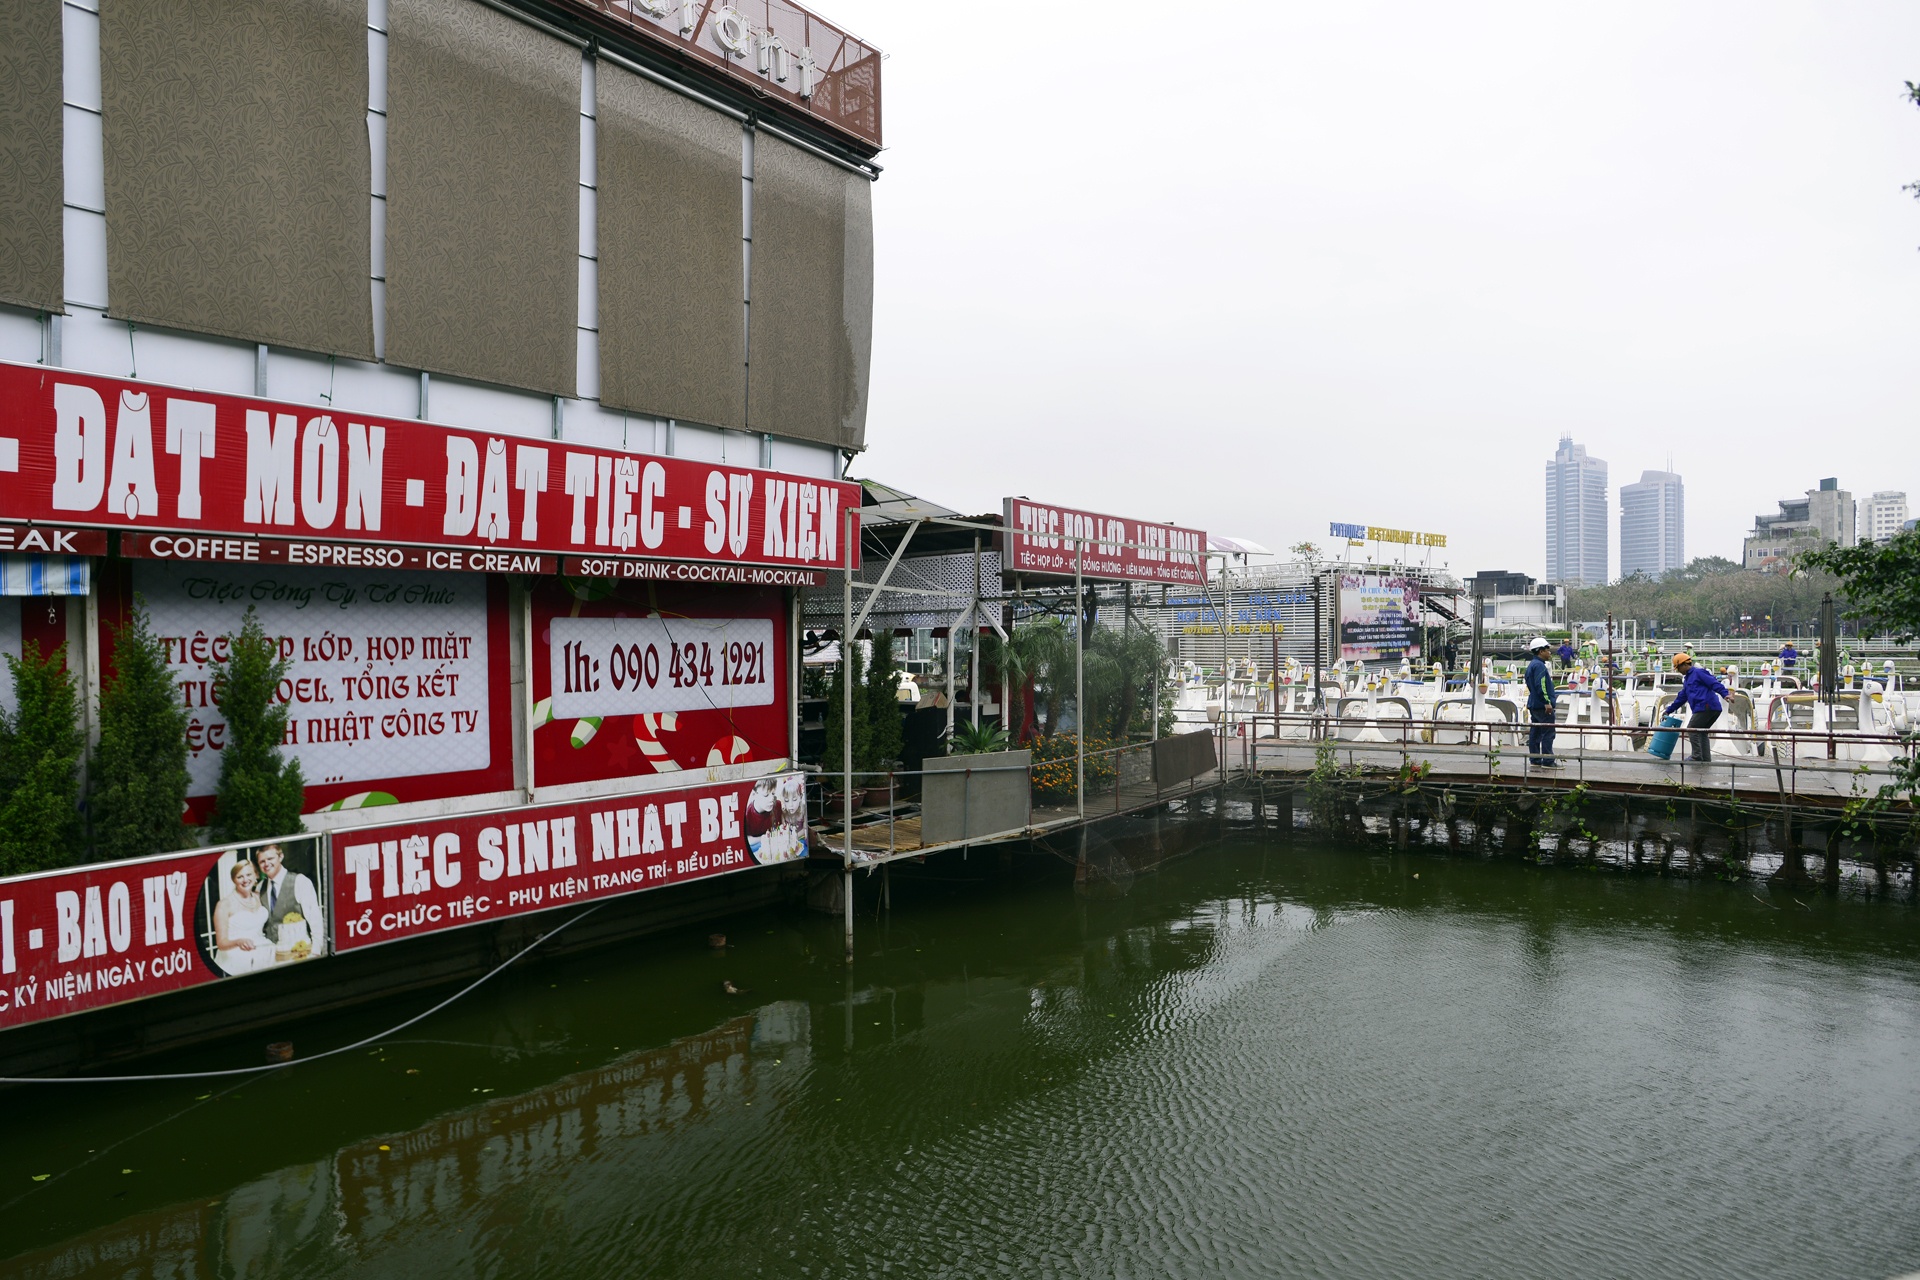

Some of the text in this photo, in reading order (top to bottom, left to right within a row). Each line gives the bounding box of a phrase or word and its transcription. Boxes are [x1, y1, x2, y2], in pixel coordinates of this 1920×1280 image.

[52, 382, 216, 520] ĐẶT
[243, 409, 386, 531] MÓN
[443, 434, 548, 544] ĐẶT
[565, 451, 666, 552] TIỆC
[704, 470, 753, 559] SỰ
[763, 478, 839, 564] KIỆN
[150, 536, 260, 562] COFFEE
[288, 544, 404, 567] ESPRESSO
[426, 551, 461, 570] ICE
[469, 552, 541, 573] CREAM
[1020, 505, 1059, 549] TIỆC
[1098, 517, 1125, 557] LỚP
[1137, 525, 1165, 562] LIÊN
[1169, 530, 1199, 565] HOAN
[1367, 526, 1413, 545] RESTAURANT
[1423, 533, 1447, 547] COFFEE
[580, 559, 620, 577] SOFT
[1138, 565, 1153, 577] HOAN
[158, 630, 230, 670] TIỆC
[366, 635, 415, 667] HỌP
[422, 631, 471, 665] MẶT
[610, 643, 660, 692] 090
[669, 641, 714, 688] 434
[720, 641, 765, 686] 1221
[268, 677, 334, 704] OEL,
[342, 663, 410, 701] TỔNG
[417, 663, 460, 698] KẾT
[307, 708, 374, 747] NHẬT
[381, 708, 446, 739] CÔNG
[452, 710, 478, 733] TY
[344, 792, 740, 903] TIỆC SINH NHẬT BÉ
[142, 870, 187, 946] HỶ
[346, 908, 373, 938] TỔ
[380, 904, 442, 931] CHỨC
[447, 895, 491, 921] TIỆC
[509, 886, 543, 908] PHỤ
[549, 877, 589, 900] KIỆN
[593, 868, 644, 890] TRANG
[676, 850, 708, 875] BIỂU
[712, 846, 744, 867] DIỄN
[14, 975, 38, 1008] KỶ
[45, 971, 92, 1001] NIỆM
[96, 959, 146, 991] NGÀY
[151, 948, 192, 978] CƯỚI
